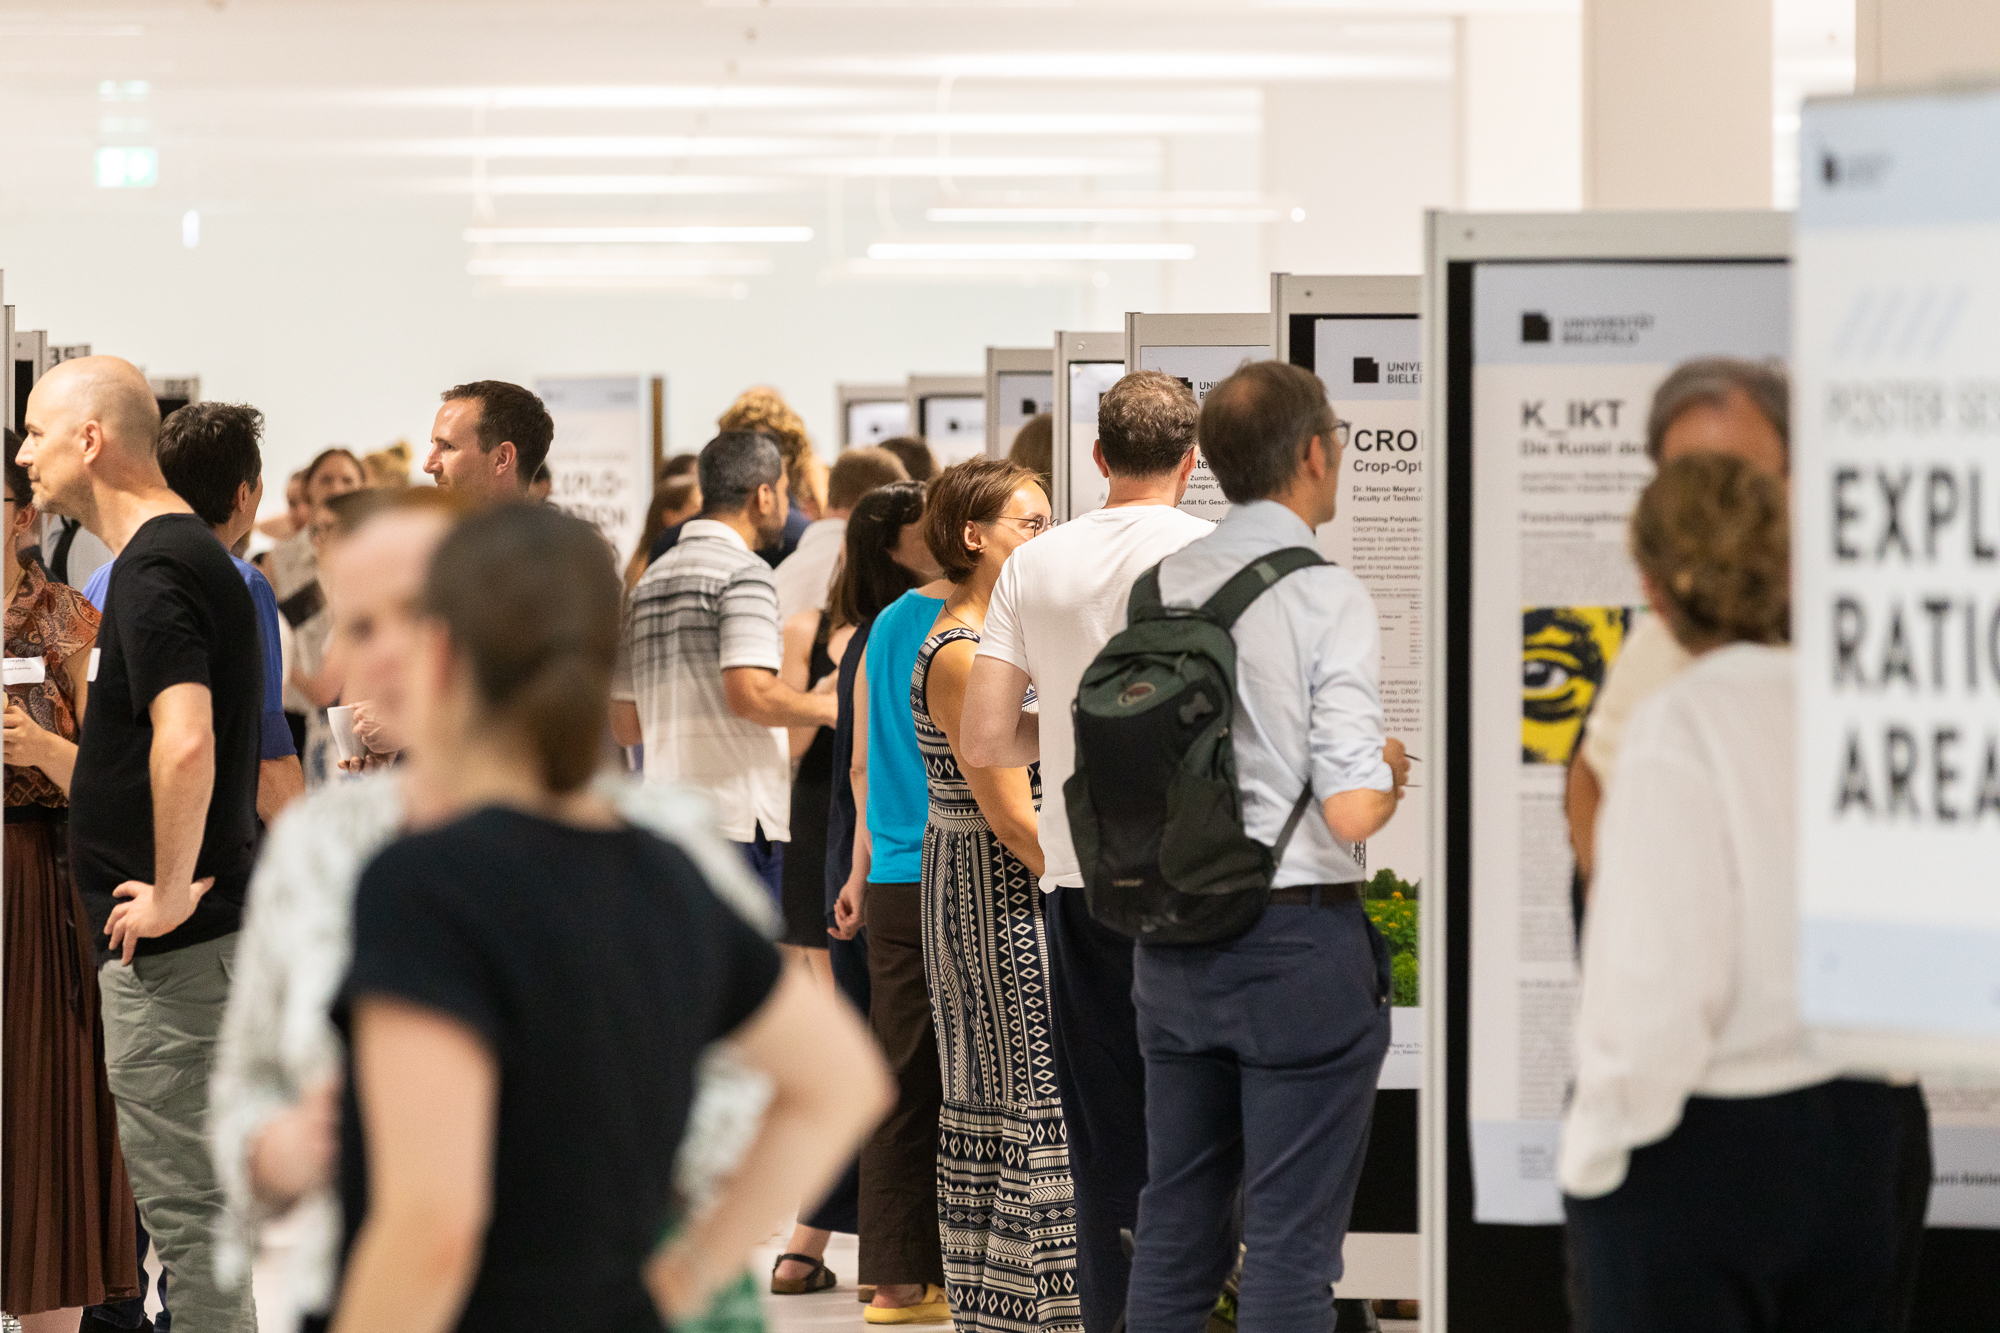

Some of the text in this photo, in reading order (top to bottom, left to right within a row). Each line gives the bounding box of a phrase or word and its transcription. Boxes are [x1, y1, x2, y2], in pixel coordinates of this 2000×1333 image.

[1387, 373, 1422, 384] BIELE
[1520, 399, 1625, 438] K_IKT
[1354, 429, 1423, 452] CRO
[1353, 485, 1364, 493] Dr.
[1366, 485, 1391, 493] Hanno
[1393, 485, 1416, 494] Meyer
[1198, 498, 1207, 506] für
[1353, 494, 1381, 503] Faculty
[1383, 494, 1391, 502] of
[1353, 516, 1389, 524] Optimizing
[1355, 573, 1385, 581] reserving
